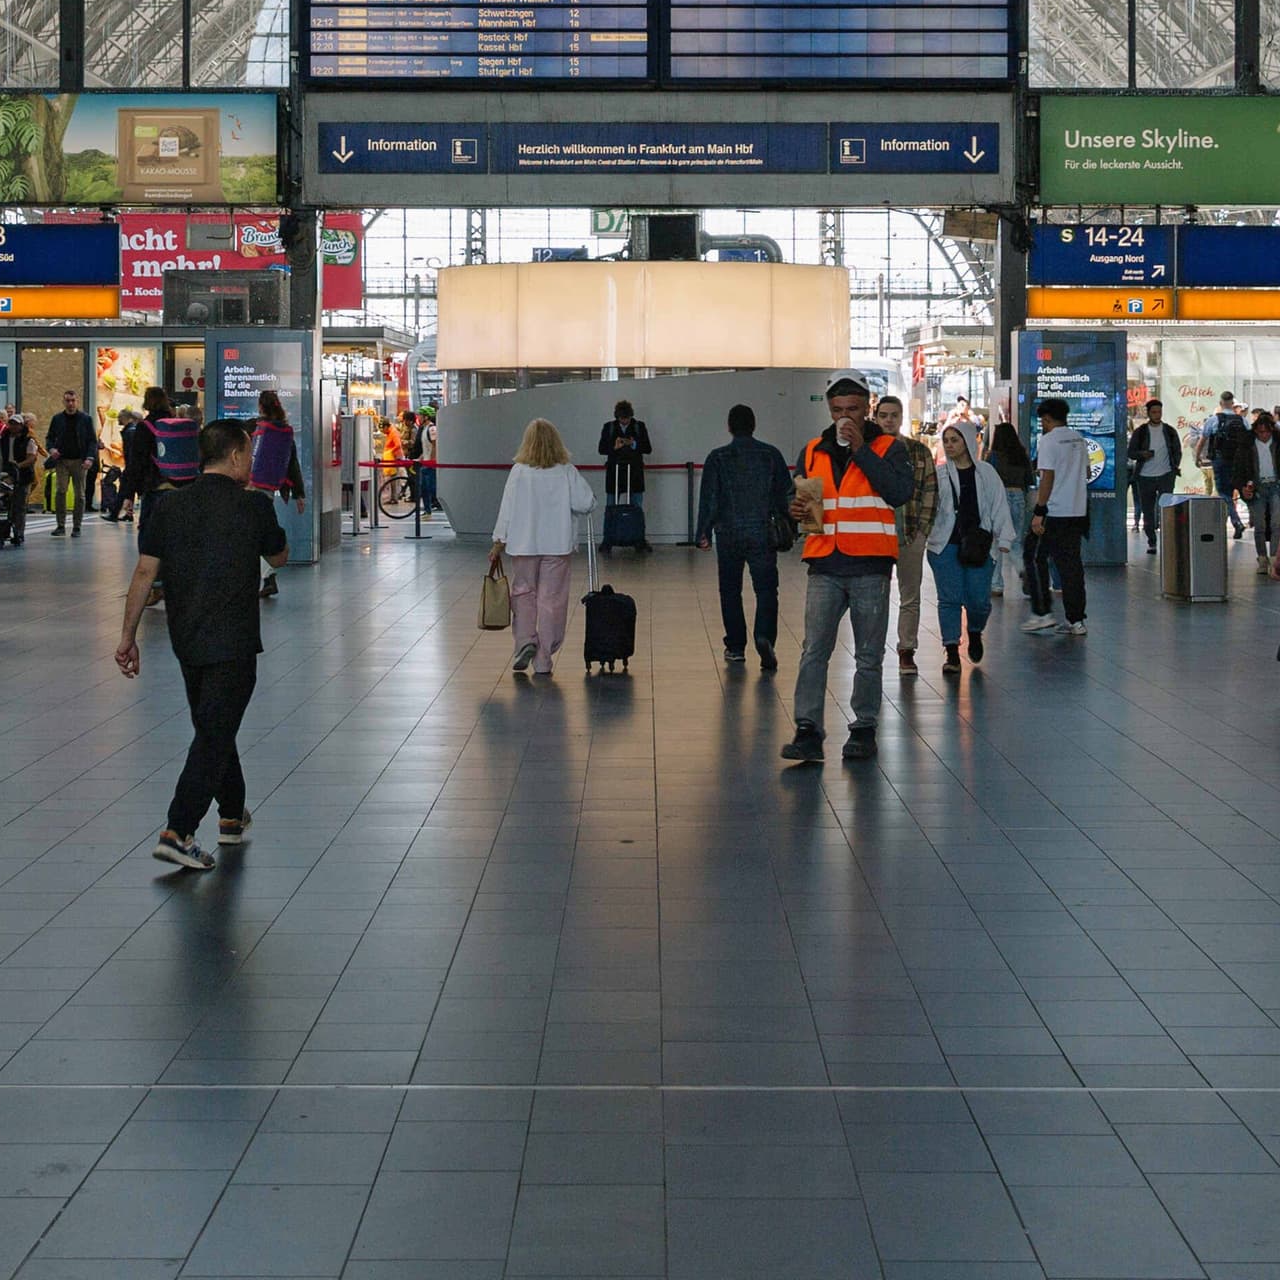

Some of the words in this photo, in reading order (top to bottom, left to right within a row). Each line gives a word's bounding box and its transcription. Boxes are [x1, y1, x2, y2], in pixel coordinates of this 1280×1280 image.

[478, 9, 534, 19] Schwetzingen
[568, 9, 580, 17] 12
[311, 19, 334, 27] 12:12
[478, 19, 519, 27] Mannheim
[522, 19, 536, 27] Hbf
[478, 33, 511, 41] Rostock
[514, 33, 528, 41] Hbf
[573, 33, 580, 41] 8
[311, 43, 334, 51] 12:20
[478, 43, 505, 51] Kassel
[508, 43, 523, 51] Hbf
[568, 43, 580, 51] 15
[478, 58, 505, 68] Siegen
[507, 58, 521, 66] Hbf
[568, 58, 580, 66] 15
[311, 68, 334, 76] 12:20
[478, 68, 516, 78] Stuttgart
[519, 68, 533, 76] Hbf
[568, 68, 580, 76] 13
[367, 138, 437, 152] Information
[880, 138, 950, 152] Information
[1065, 130, 1137, 149] Unsere
[1141, 128, 1220, 154] Skyline.
[519, 144, 560, 154] Herzlich
[563, 144, 625, 154] willkommen
[628, 144, 637, 154] in
[640, 144, 686, 154] Frankfurt
[688, 146, 704, 154] am
[707, 144, 732, 154] Main
[735, 144, 754, 154] Hbf
[1065, 160, 1079, 169] Für
[1082, 160, 1097, 169] die
[1100, 160, 1140, 169] leckerste
[1144, 160, 1184, 170] Aussicht.
[140, 168, 198, 176] KAKAO-MOUSSE
[1061, 229, 1074, 242] S
[1085, 226, 1145, 246] 14-24
[535, 248, 553, 262] 12
[1090, 254, 1124, 264] Ausgang
[1125, 254, 1145, 263] Nord
[132, 255, 221, 277] mehr!
[224, 365, 255, 374] Arbeite
[1037, 366, 1068, 375] Arbeite
[224, 373, 277, 381] ehrenamtlich
[1037, 374, 1090, 383] ehrenamtlich
[224, 381, 235, 389] für
[237, 381, 251, 389] die
[1037, 382, 1048, 391] für
[1050, 382, 1063, 390] die
[1037, 390, 1108, 398] Bahnhofsmission.
